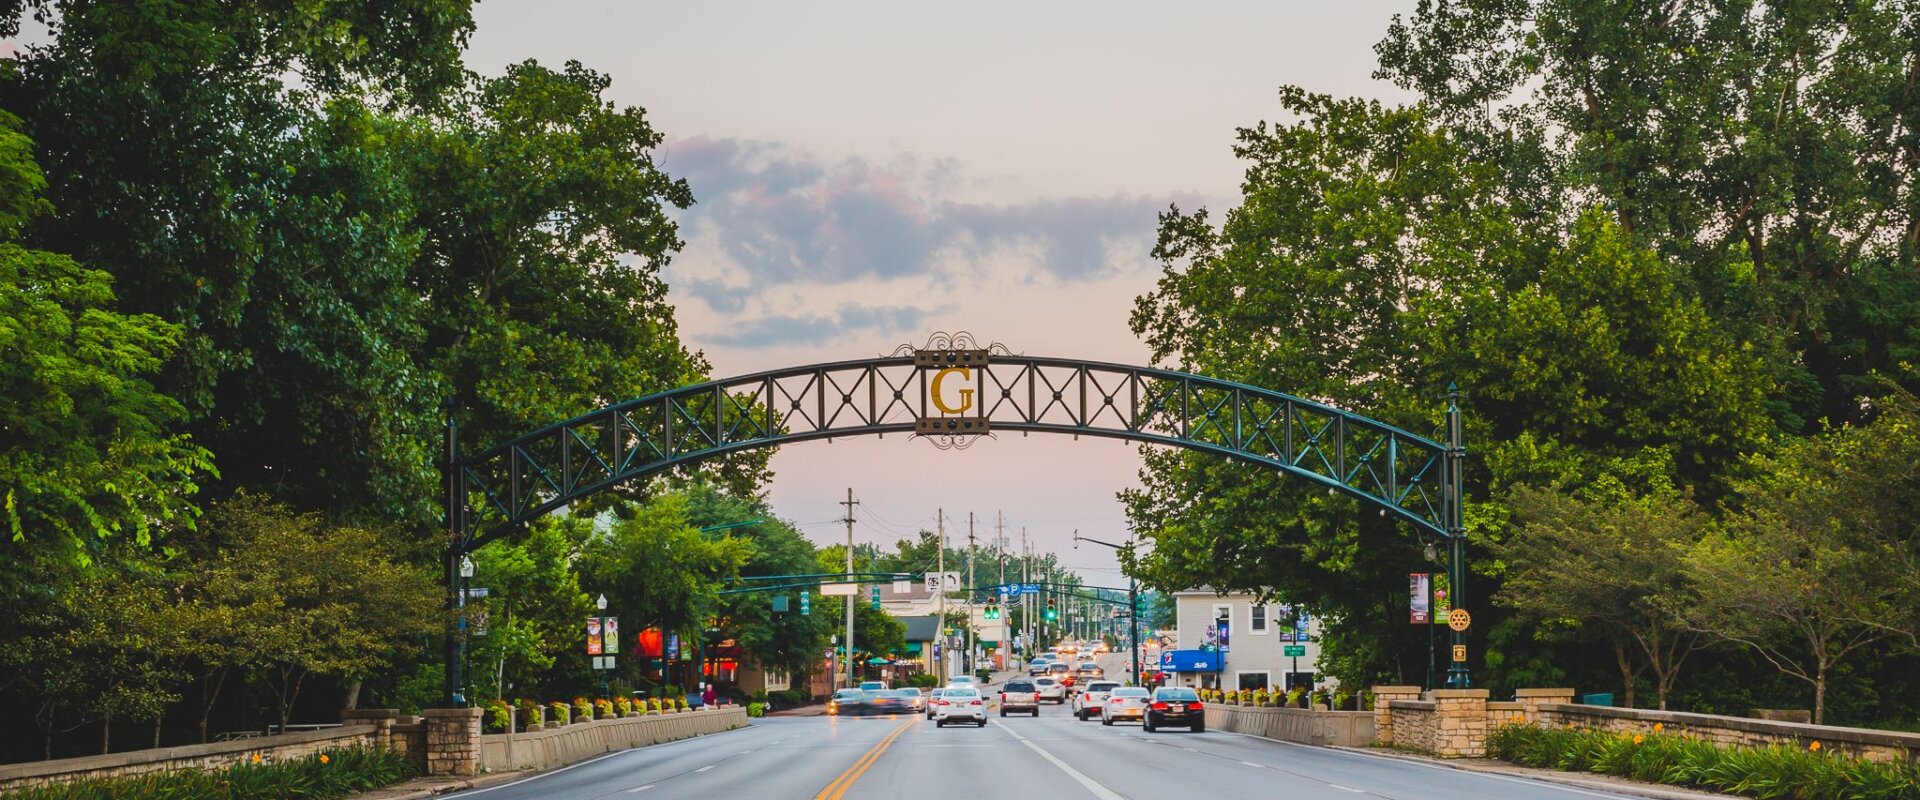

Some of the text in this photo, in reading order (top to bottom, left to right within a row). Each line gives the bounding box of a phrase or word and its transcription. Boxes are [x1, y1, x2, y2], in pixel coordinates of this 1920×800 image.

[930, 367, 974, 414] G
[928, 577, 939, 587] 62
[1011, 586, 1018, 594] P
